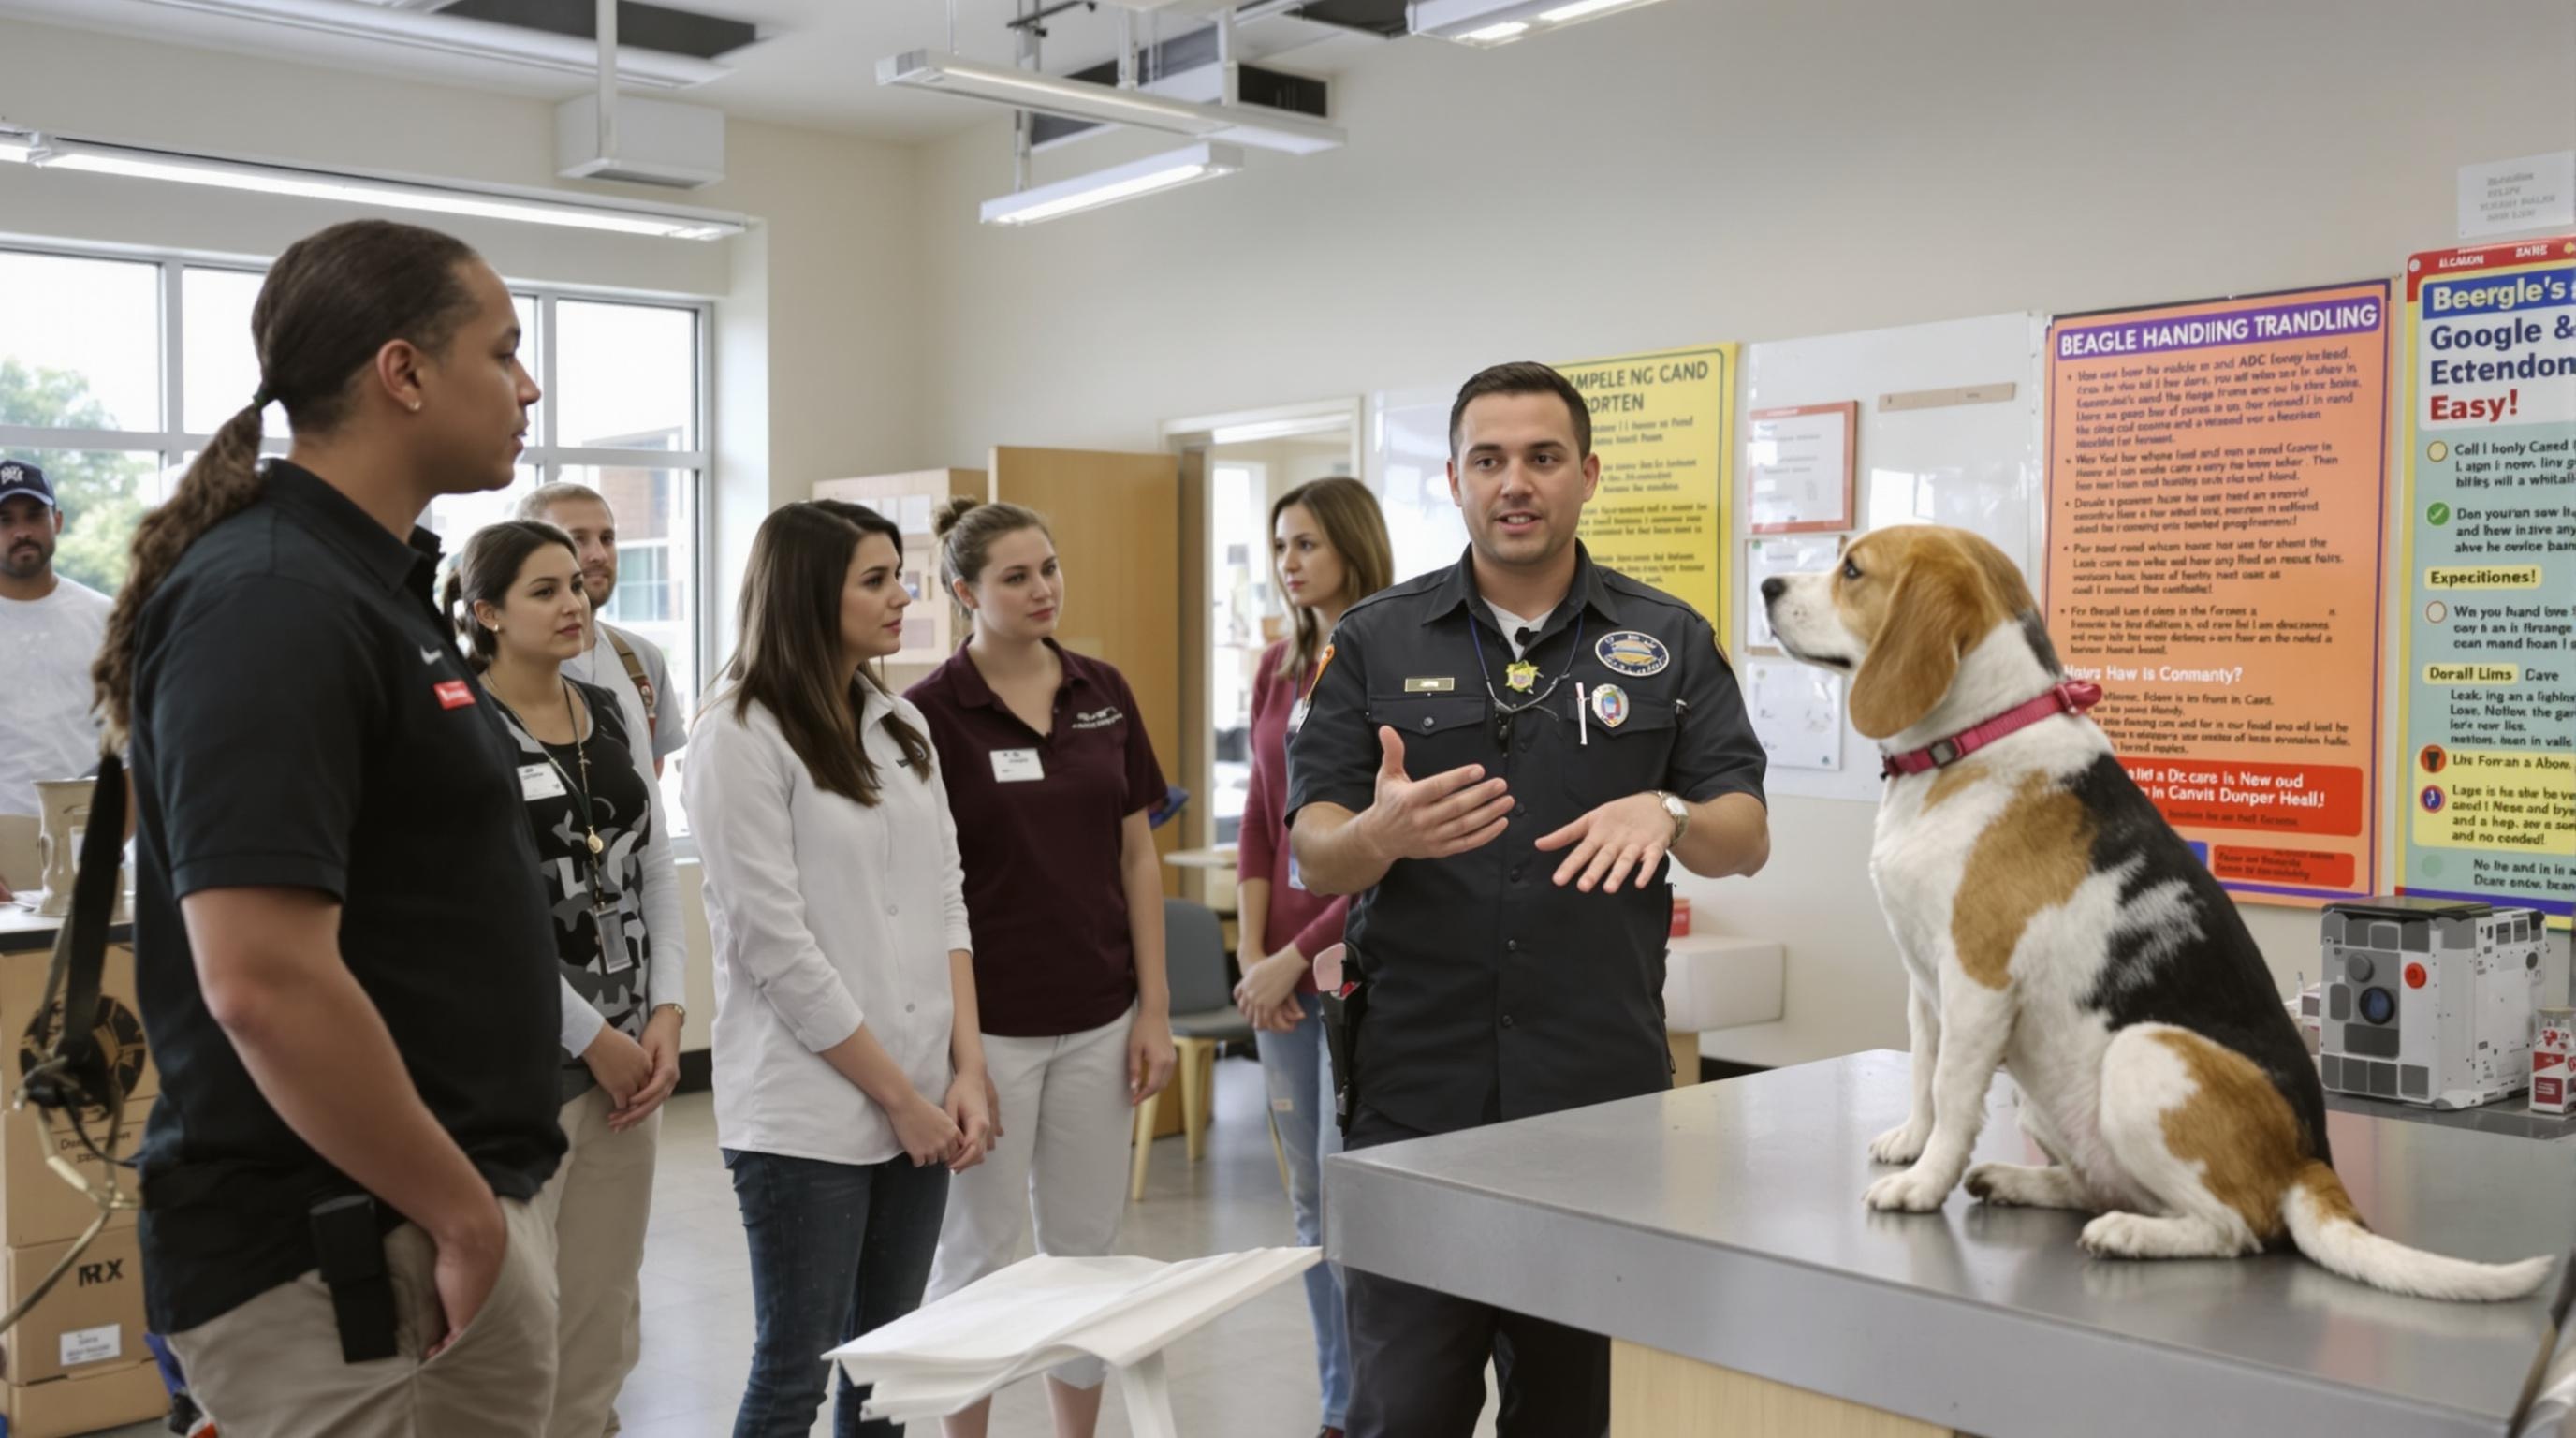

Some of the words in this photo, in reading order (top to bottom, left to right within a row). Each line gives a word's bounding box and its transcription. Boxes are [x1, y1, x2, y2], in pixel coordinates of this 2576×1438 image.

[2433, 276, 2566, 311] Beergle's
[2060, 330, 2137, 356] BEAGLE
[2254, 304, 2378, 338] TRANDLING
[2430, 317, 2542, 351] Google
[1659, 361, 1709, 383] CAND
[2239, 354, 2266, 367] ADC
[2430, 389, 2518, 422] Easy!
